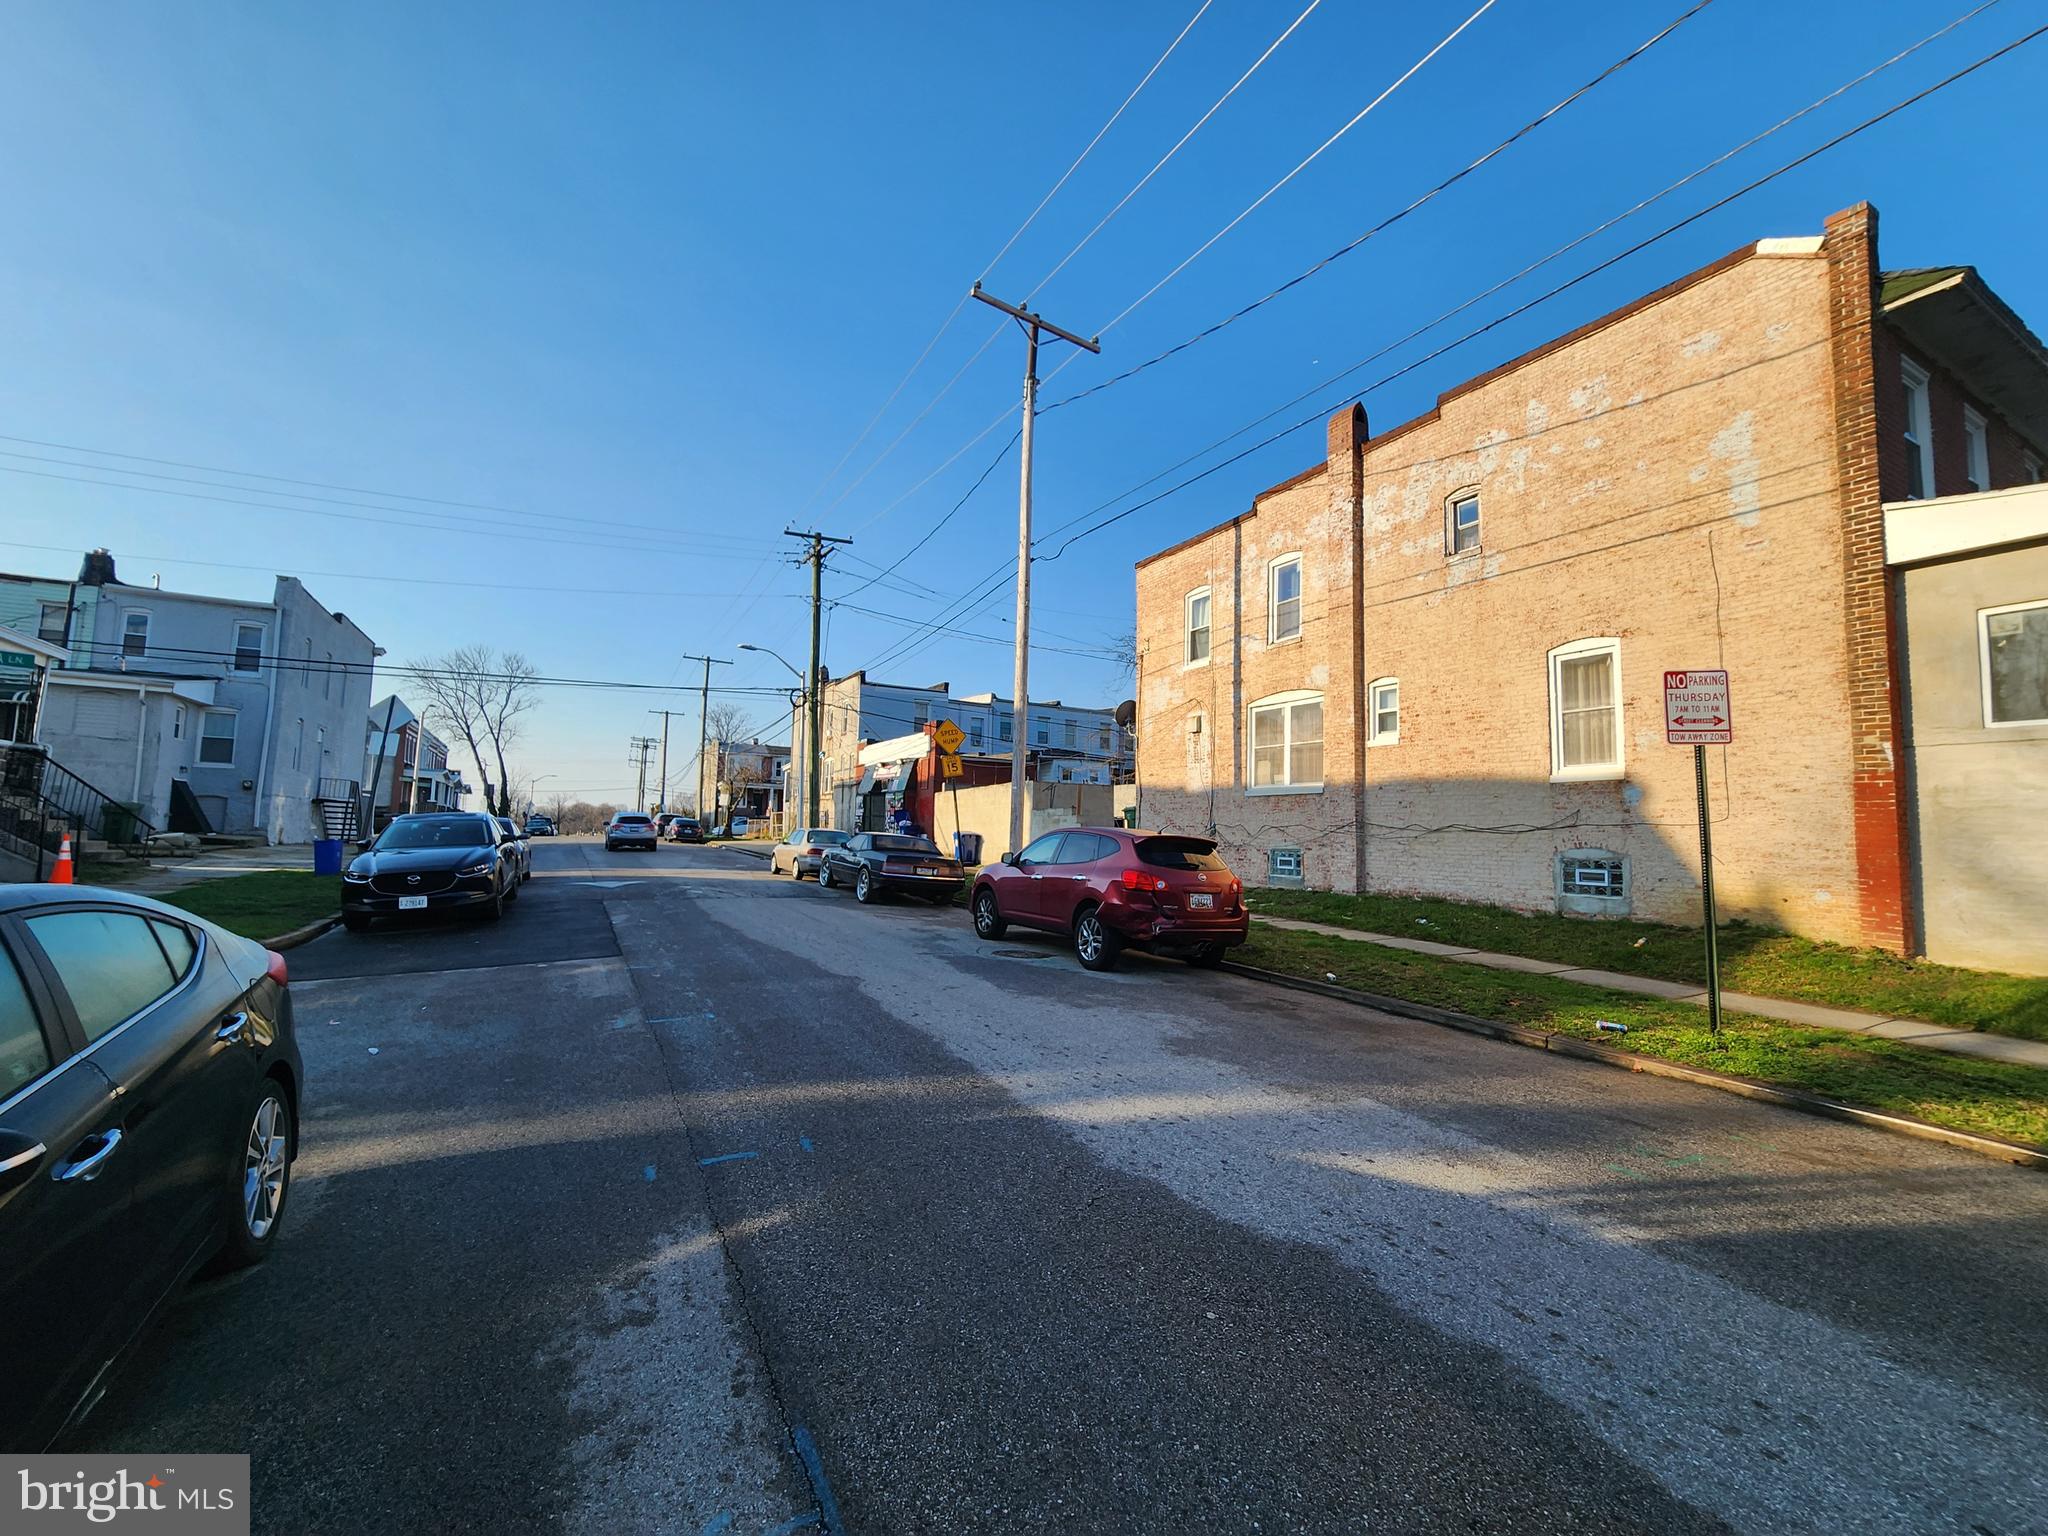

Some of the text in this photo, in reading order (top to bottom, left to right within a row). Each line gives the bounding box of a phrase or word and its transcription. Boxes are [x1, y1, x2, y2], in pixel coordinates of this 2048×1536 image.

[1667, 674, 1725, 688] NO PARKING
[1668, 692, 1725, 702] THURSDAY
[1691, 705, 1700, 713] TO
[940, 729, 959, 737] SPEED
[1670, 732, 1729, 741] TOW AWAY ZONE
[947, 762, 959, 773] 15
